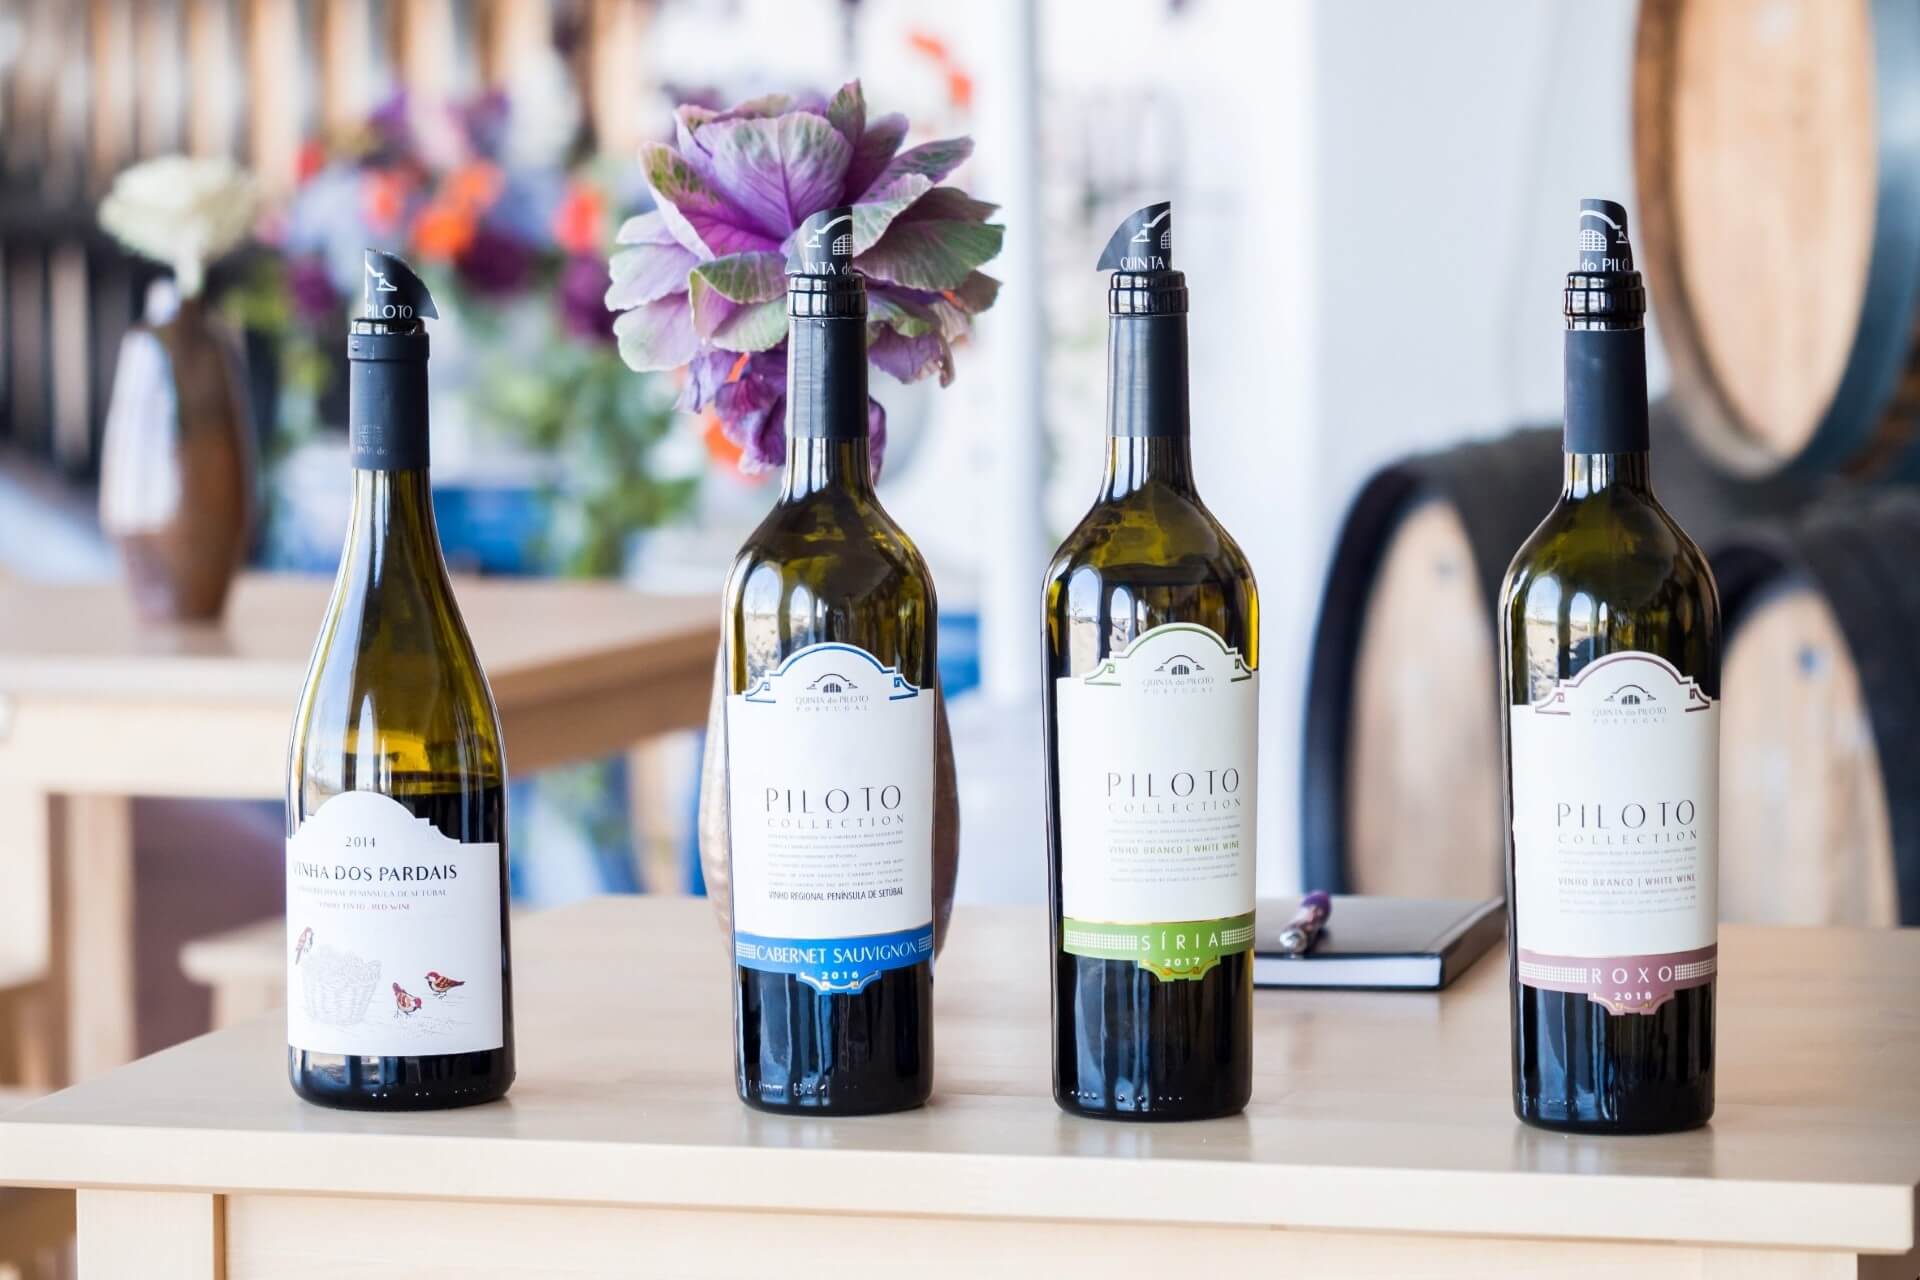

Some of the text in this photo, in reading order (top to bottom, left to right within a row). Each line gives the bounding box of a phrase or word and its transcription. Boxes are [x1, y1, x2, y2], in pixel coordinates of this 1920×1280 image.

[1120, 256, 1165, 272] QUINTA
[1582, 258, 1597, 272] do
[1107, 768, 1239, 797] PILOTO
[766, 785, 901, 814] PILOTO
[1108, 798, 1241, 813] COLLECTION
[768, 814, 904, 829] COLLECTION
[1557, 799, 1695, 829] PILOTO
[346, 836, 376, 848] 2014
[1558, 830, 1697, 845] COLLECTION
[1143, 846, 1183, 855] BRANCO
[1194, 843, 1219, 852] WHITE
[1223, 840, 1239, 850] WINE
[335, 865, 373, 882] DOS
[379, 864, 458, 882] PARDAIS
[1592, 877, 1633, 887] BRANCO
[1645, 876, 1673, 886] WHITE
[1676, 873, 1696, 883] WINE
[790, 891, 824, 900] REGIONAL
[867, 888, 878, 899] DE
[1141, 931, 1218, 950] SÍRIA
[756, 943, 917, 964] CABERNET SAUVIGNON
[1164, 957, 1200, 967] 2017
[822, 971, 859, 980] 2016
[1592, 966, 1672, 984] ROXO
